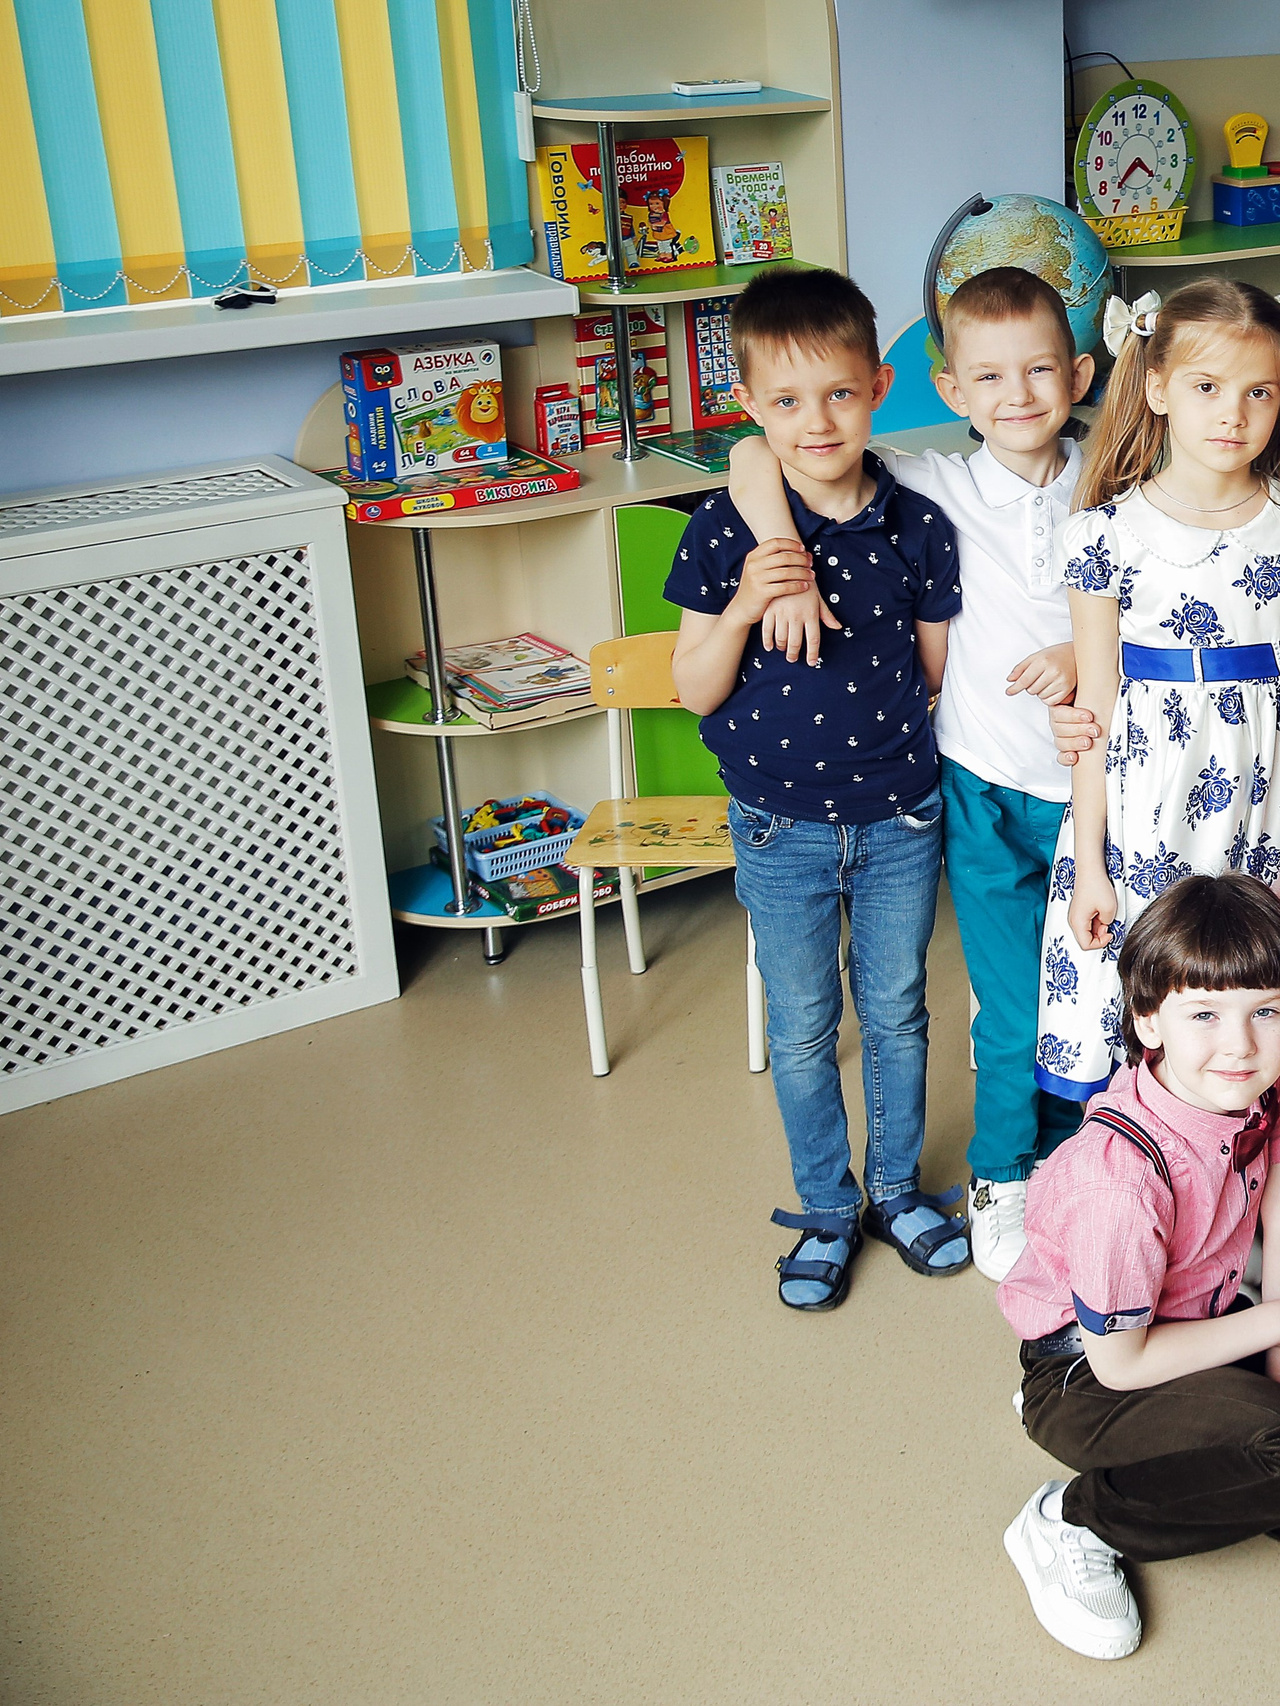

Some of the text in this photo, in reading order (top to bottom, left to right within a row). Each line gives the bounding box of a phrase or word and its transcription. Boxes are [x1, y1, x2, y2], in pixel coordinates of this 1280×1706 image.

[1112, 111, 1126, 126] 11
[1132, 104, 1147, 119] 12
[1154, 111, 1160, 125] 1
[1098, 131, 1112, 146] 10
[1167, 129, 1175, 142] 2
[616, 150, 656, 164] льбом
[1095, 156, 1103, 171] 9
[1171, 154, 1178, 168] 3
[618, 161, 672, 174] азвитию
[617, 172, 648, 187] речи
[727, 172, 779, 187] Времена
[1164, 178, 1172, 191] 4
[742, 183, 768, 193] года
[1099, 181, 1107, 195] 8
[550, 152, 572, 240] Говорим
[1112, 199, 1121, 213] 7
[1150, 198, 1158, 211] 5
[546, 223, 563, 279] правильно
[759, 242, 768, 250] 20
[413, 351, 476, 371] АЗБУКА
[368, 412, 378, 446] АКАДЕМИЯ
[376, 406, 388, 450] РАЗВИТИЯ
[476, 478, 557, 503] ВИКТОРИНА
[538, 896, 578, 914] СОБЕРИ
